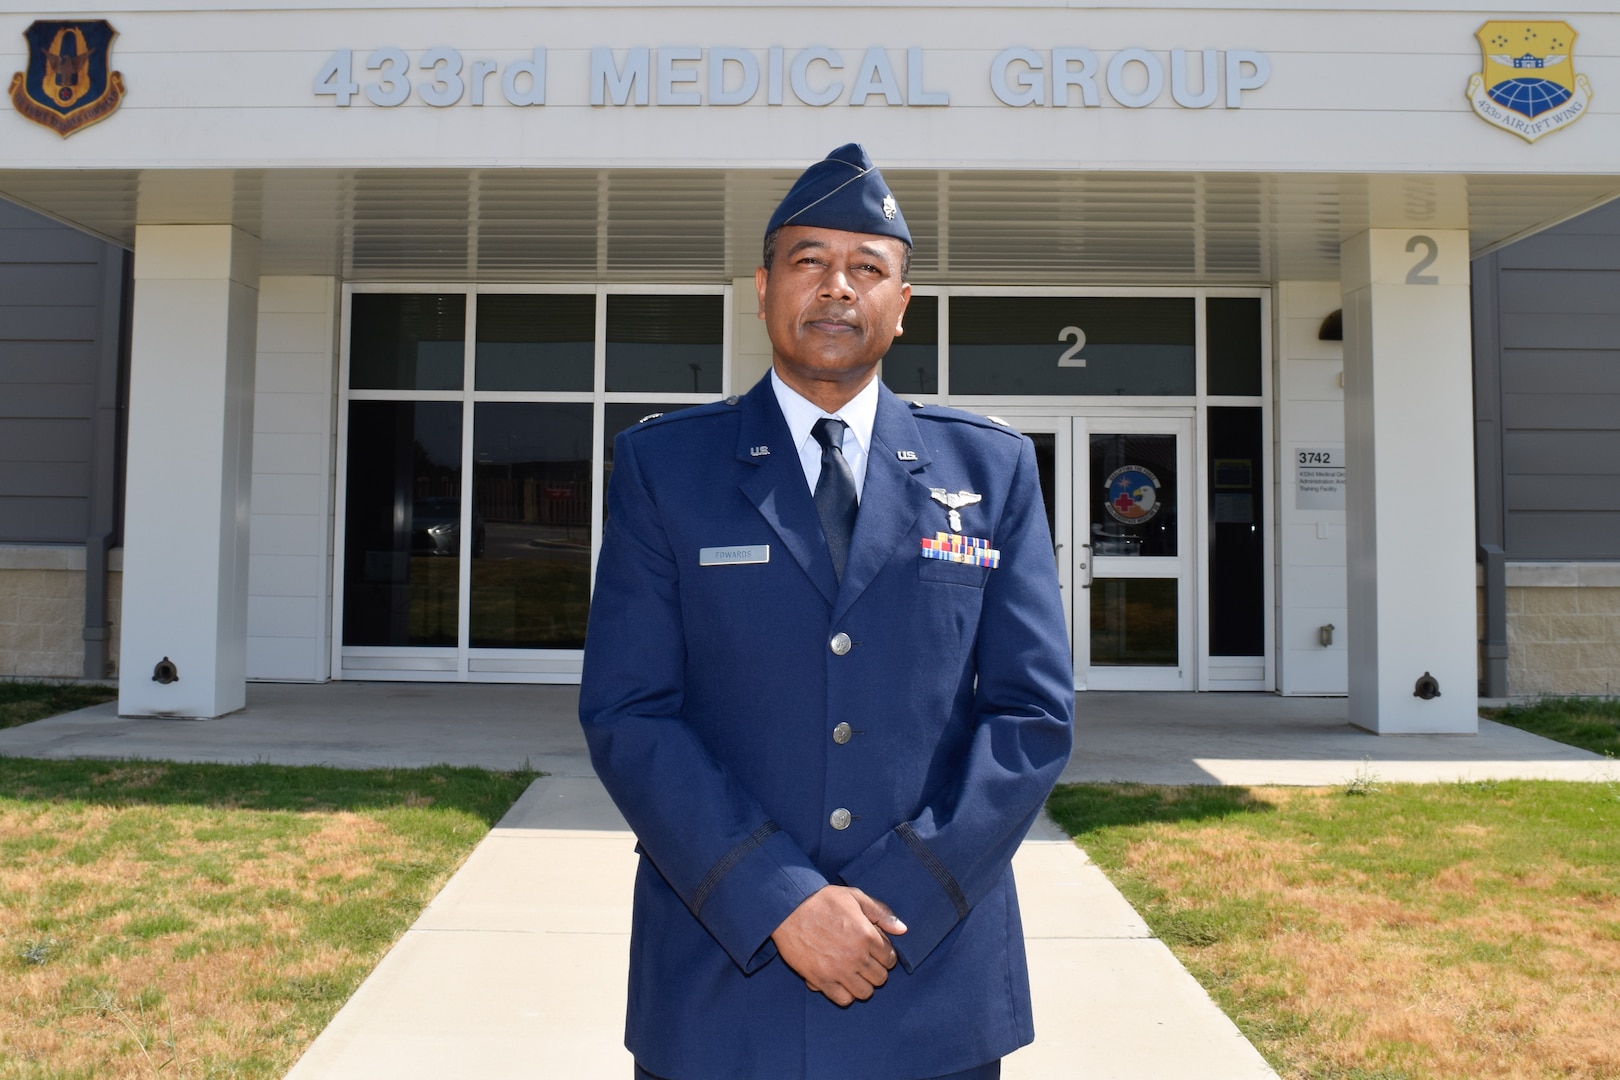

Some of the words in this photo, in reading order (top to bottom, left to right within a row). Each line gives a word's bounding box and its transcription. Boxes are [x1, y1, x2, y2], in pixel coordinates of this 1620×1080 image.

[314, 48, 547, 107] 433rd
[590, 46, 949, 107] MEDICAL
[989, 47, 1271, 109] GROUP
[1502, 115, 1550, 134] AIRLIFT
[1551, 101, 1583, 124] WING
[1405, 234, 1439, 285] 2
[1057, 325, 1087, 368] 2
[1299, 452, 1331, 464] 3742
[715, 551, 751, 559] EDWARDS
